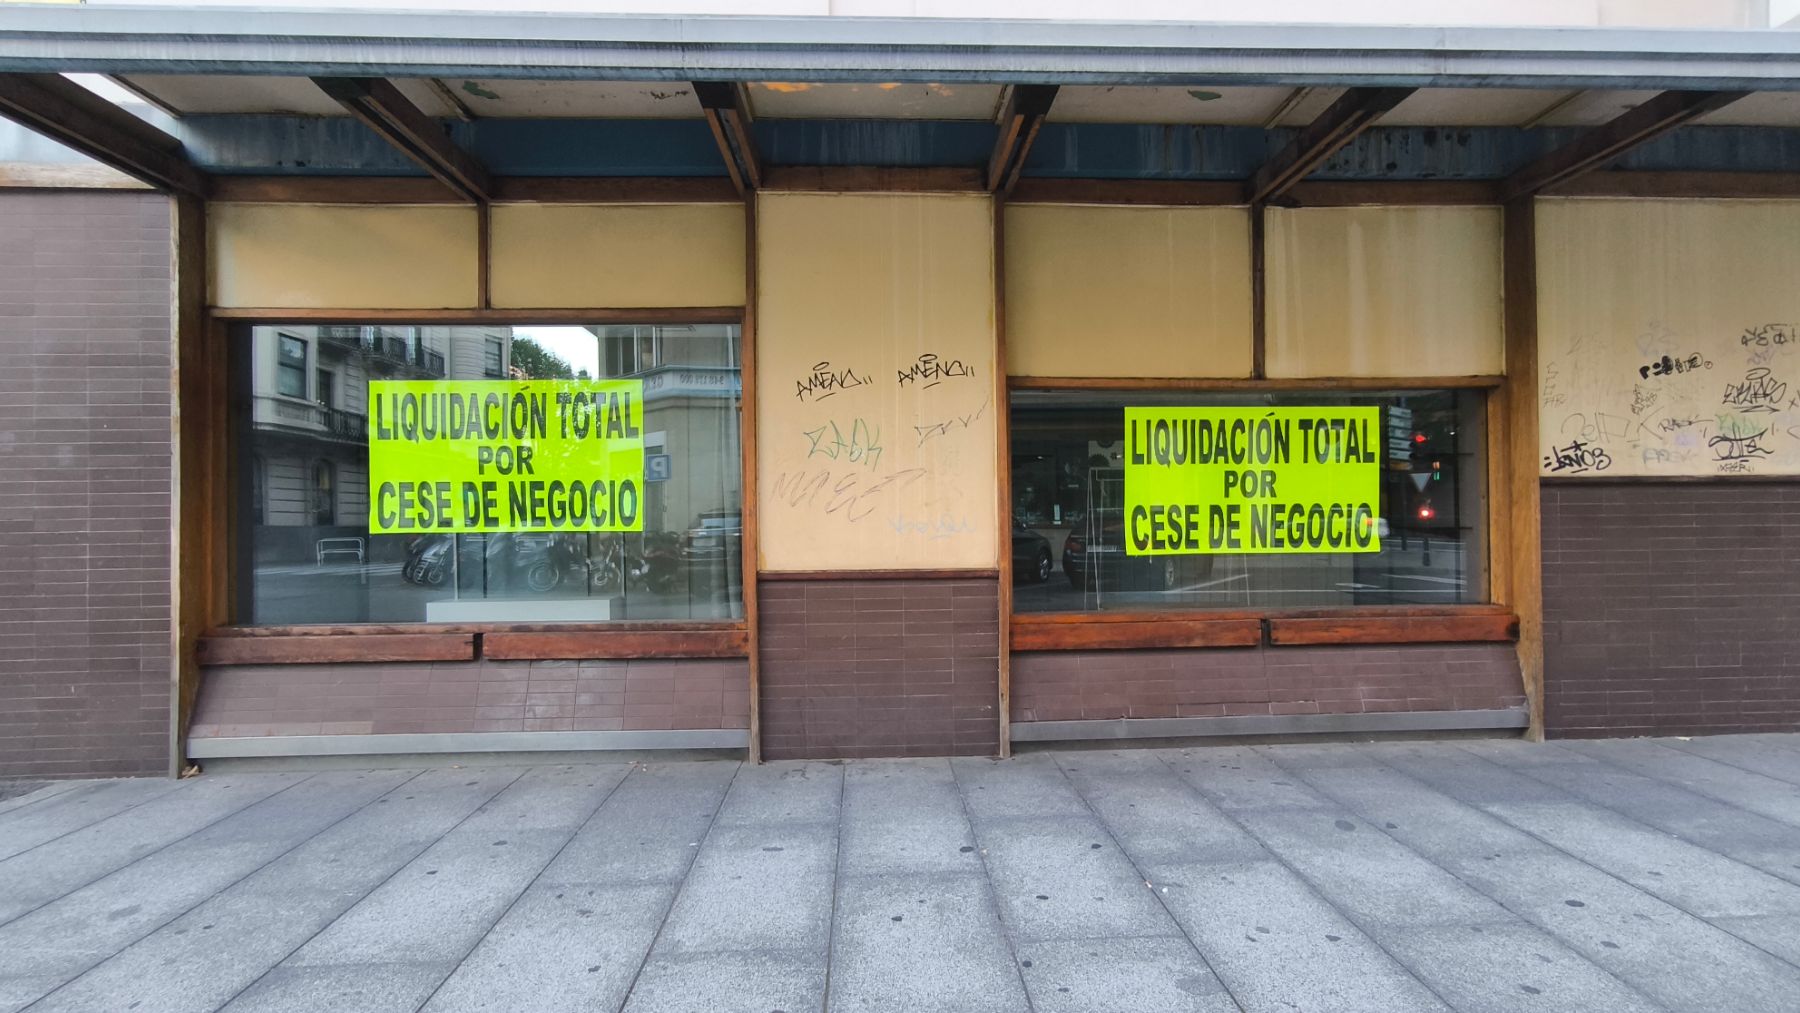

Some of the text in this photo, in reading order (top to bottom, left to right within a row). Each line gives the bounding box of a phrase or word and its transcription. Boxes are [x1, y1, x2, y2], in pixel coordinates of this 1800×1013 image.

[376, 385, 639, 443] LIQUIDACIÓN TOTAL
[478, 445, 534, 476] POR
[1131, 411, 1290, 468] LIQUIDACIÓN
[1297, 418, 1376, 465] TOTAL
[377, 479, 638, 529] CESE DE NEGOCIO
[1224, 470, 1277, 499] POR
[1130, 502, 1373, 551] CESE DE NEGOCIO
